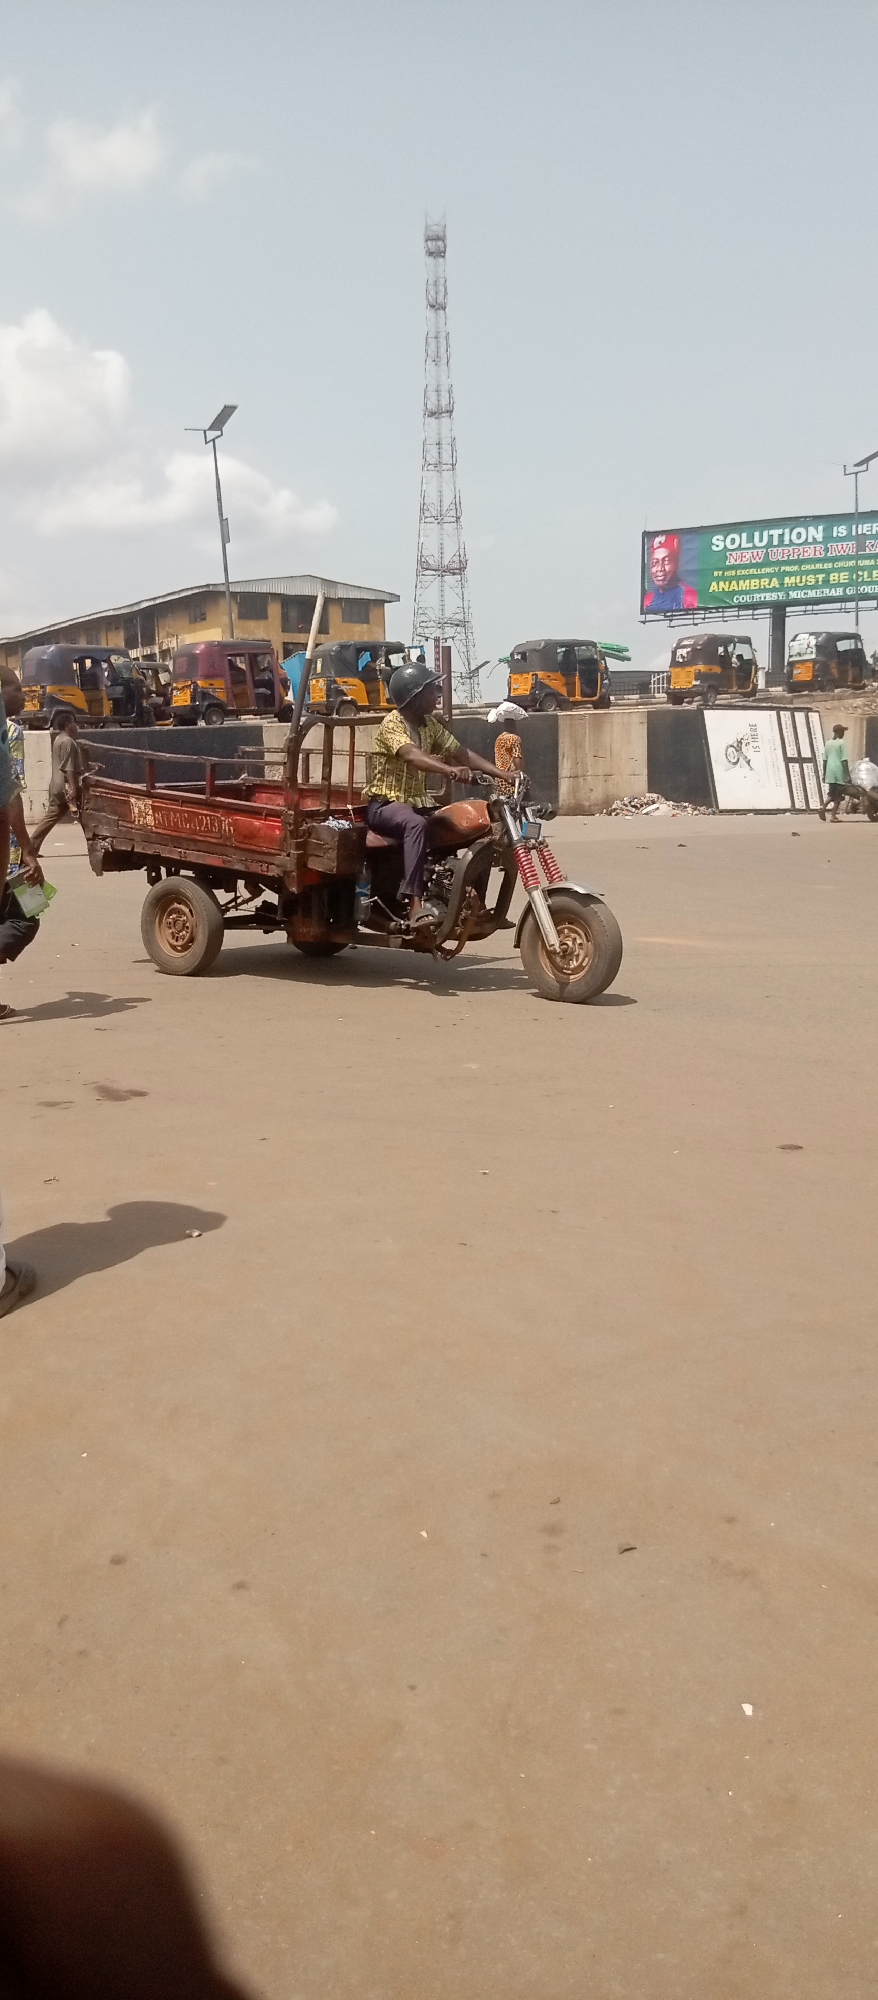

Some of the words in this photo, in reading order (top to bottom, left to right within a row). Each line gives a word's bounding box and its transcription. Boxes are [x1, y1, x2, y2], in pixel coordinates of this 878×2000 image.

[711, 526, 823, 551] SOLUTION
[832, 525, 847, 538] IS
[726, 550, 765, 565] NEW
[769, 545, 824, 561] UPPER
[737, 567, 779, 576] EXCELLENCY
[801, 562, 833, 571] CHARLES
[709, 577, 779, 592] ANAMBRA
[784, 574, 825, 587] MUST
[829, 572, 849, 584] BE
[733, 592, 786, 603] COURTESY:
[789, 587, 843, 599] MICMERAH
[749, 723, 759, 743] HERE
[752, 745, 761, 753] IS
